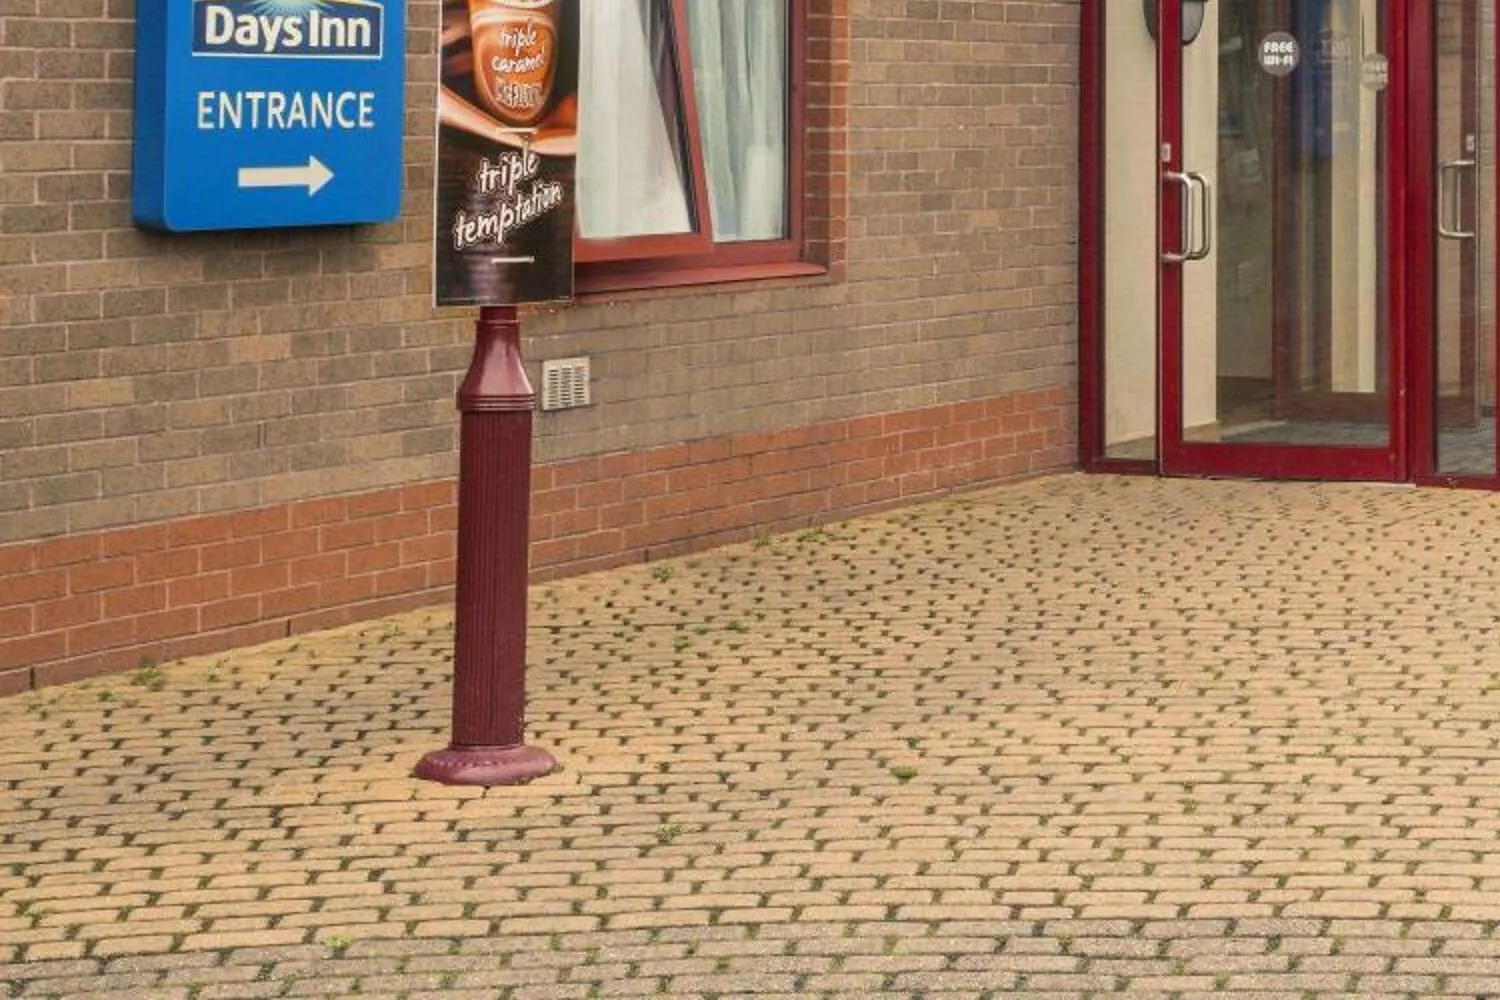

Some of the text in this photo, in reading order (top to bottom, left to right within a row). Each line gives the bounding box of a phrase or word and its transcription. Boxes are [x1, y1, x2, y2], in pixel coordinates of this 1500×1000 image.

[205, 4, 372, 52] Days Inn
[1263, 41, 1294, 54] FREE
[197, 91, 376, 129] ENTRANCE
[479, 140, 538, 197] triple
[454, 184, 563, 248] temptation
